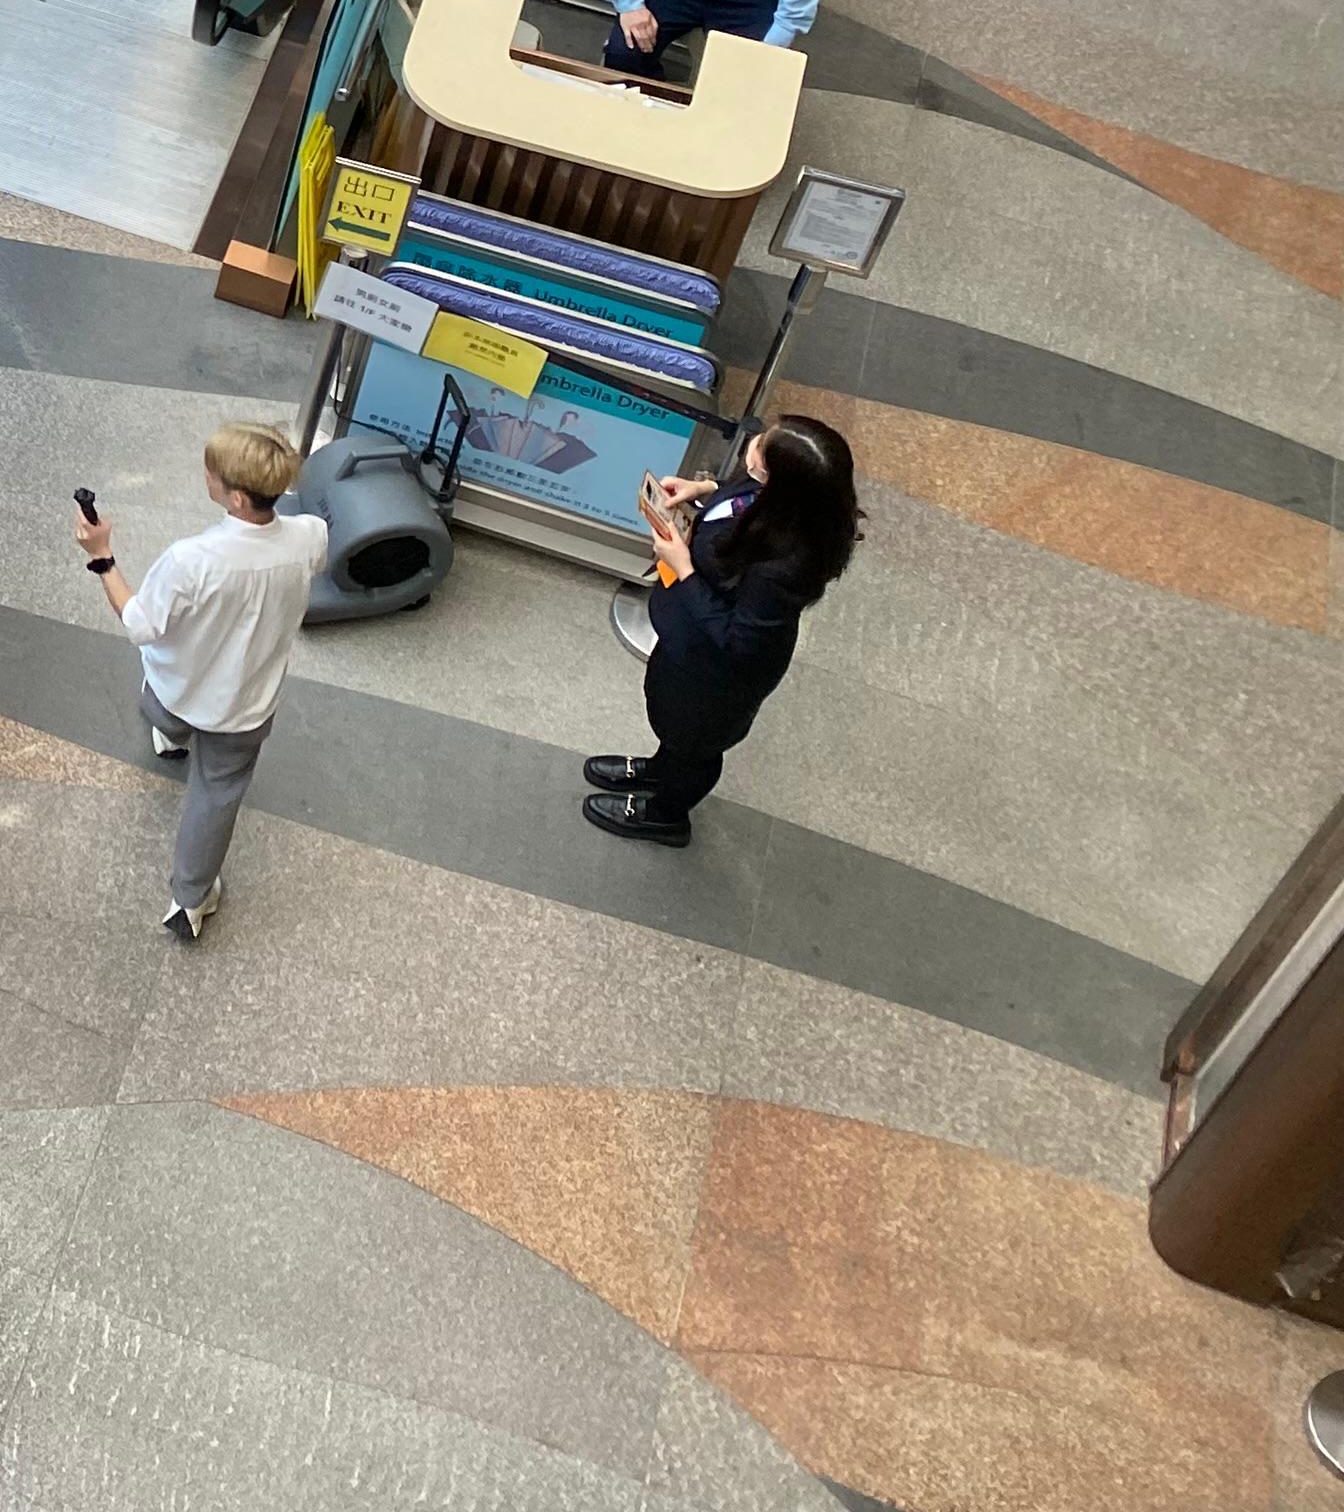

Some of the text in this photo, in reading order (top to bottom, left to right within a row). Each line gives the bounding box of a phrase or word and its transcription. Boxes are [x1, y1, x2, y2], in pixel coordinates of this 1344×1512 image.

[343, 176, 395, 202] 出口
[336, 200, 392, 225] EXIT
[534, 289, 618, 322] Umbrella
[622, 314, 673, 338] Dryer
[540, 374, 670, 421] mbrella Dryer
